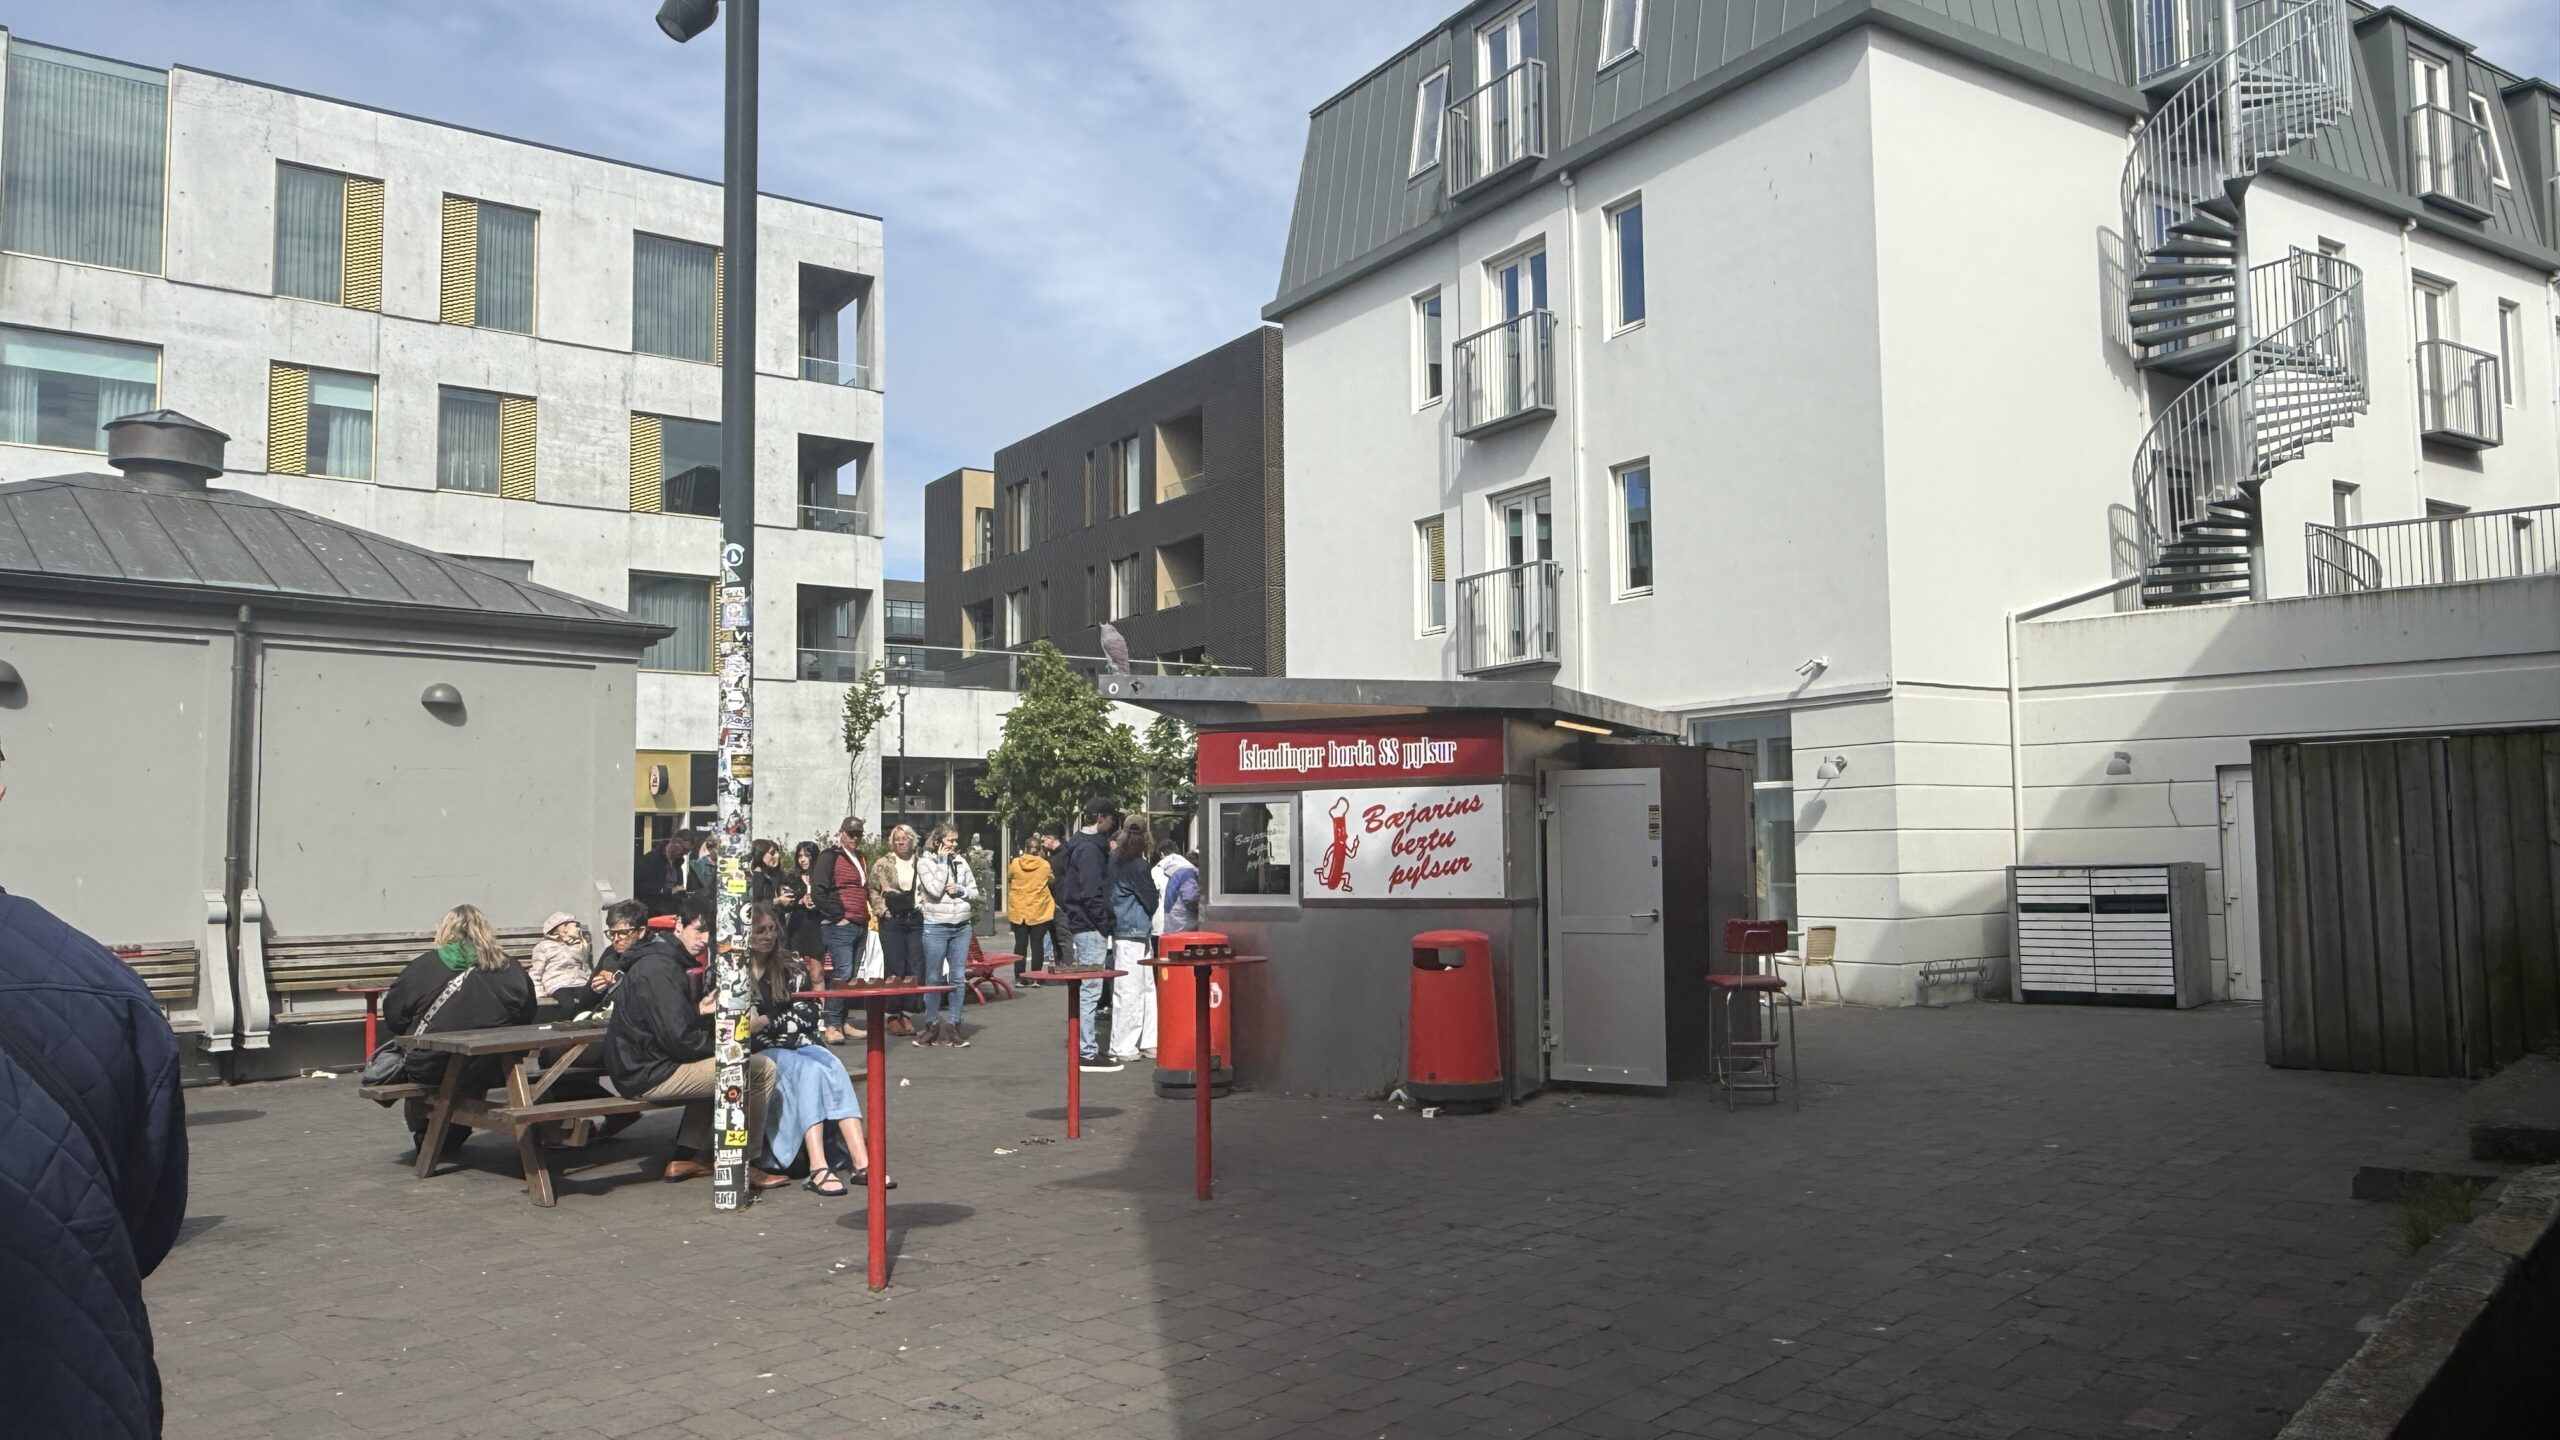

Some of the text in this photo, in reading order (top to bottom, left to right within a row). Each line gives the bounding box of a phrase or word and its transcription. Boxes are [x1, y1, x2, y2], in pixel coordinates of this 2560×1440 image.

[1239, 739, 1325, 773] Íslendingar
[1379, 738, 1399, 765] SS
[1403, 737, 1457, 769] pylsur
[1362, 794, 1483, 834] Bæjarins
[1391, 828, 1456, 861] beztu
[1389, 854, 1472, 894] pylsur
